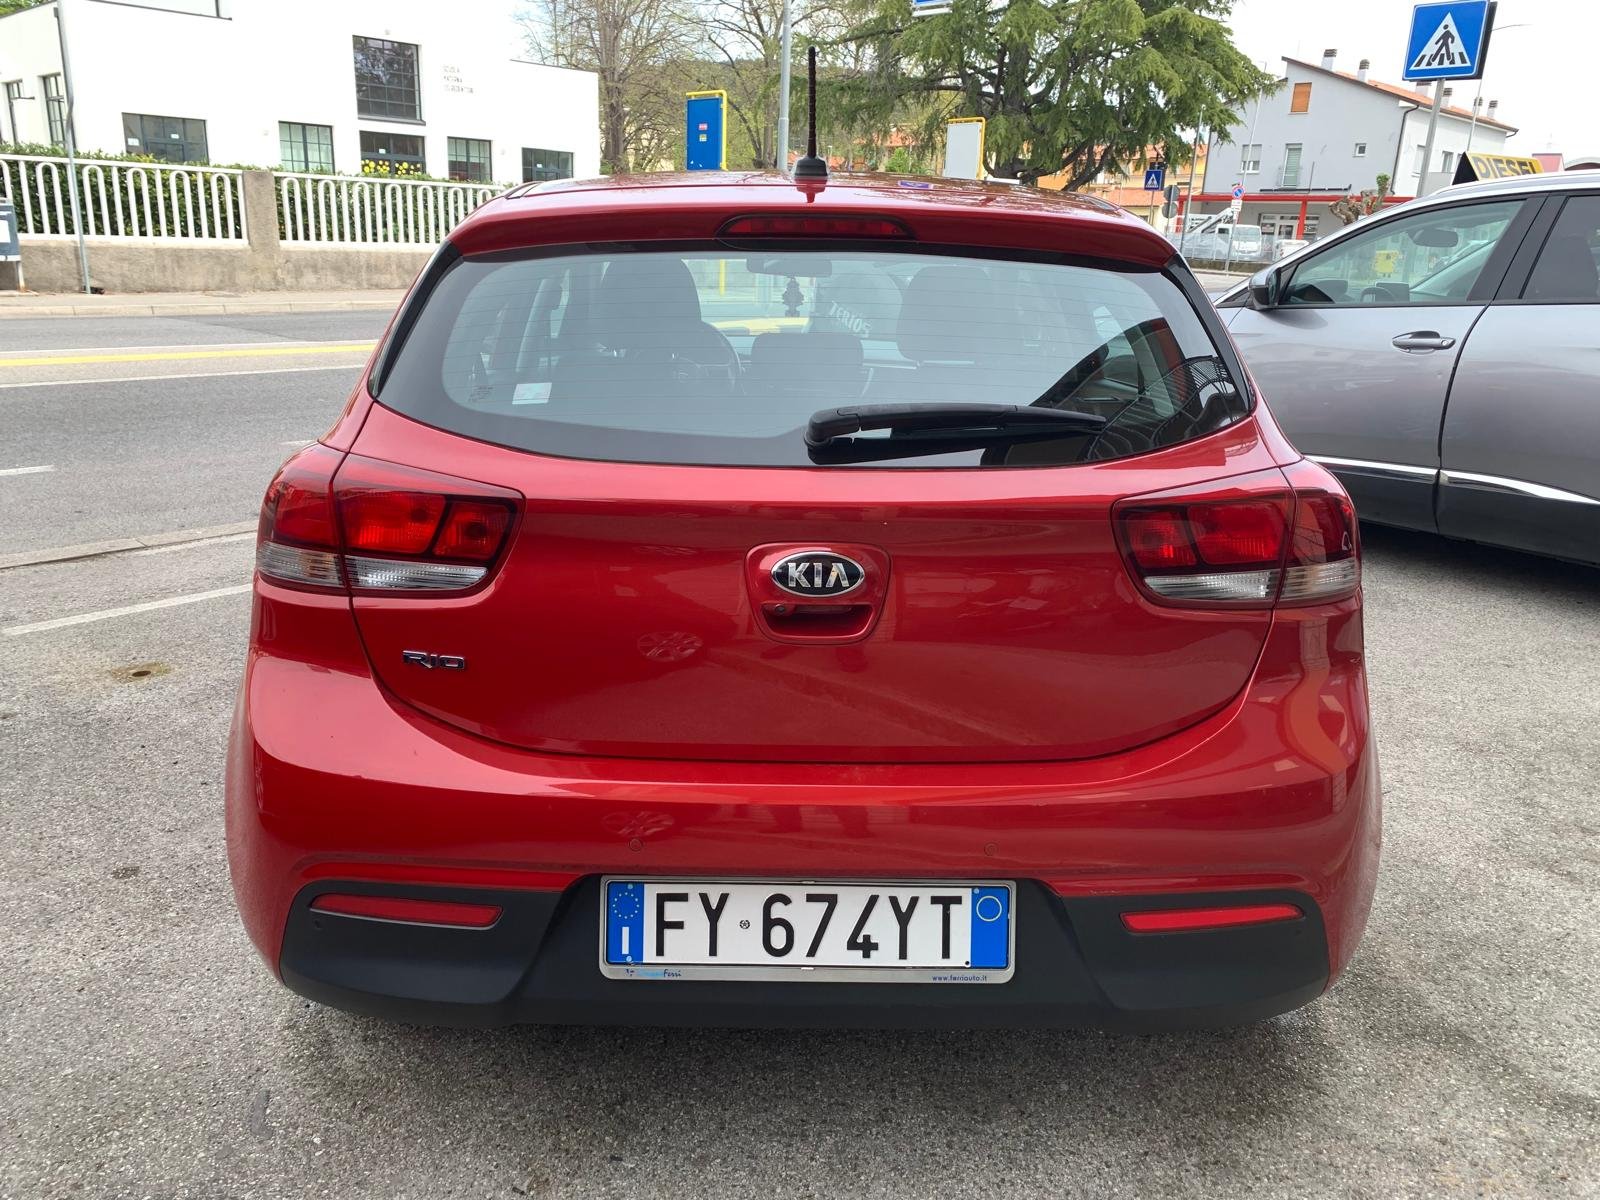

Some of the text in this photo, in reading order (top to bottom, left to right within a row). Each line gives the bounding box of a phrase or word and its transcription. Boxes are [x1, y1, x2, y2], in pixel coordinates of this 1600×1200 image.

[788, 562, 850, 588] KIA
[656, 892, 730, 957] FY
[762, 893, 962, 960] 674YT
